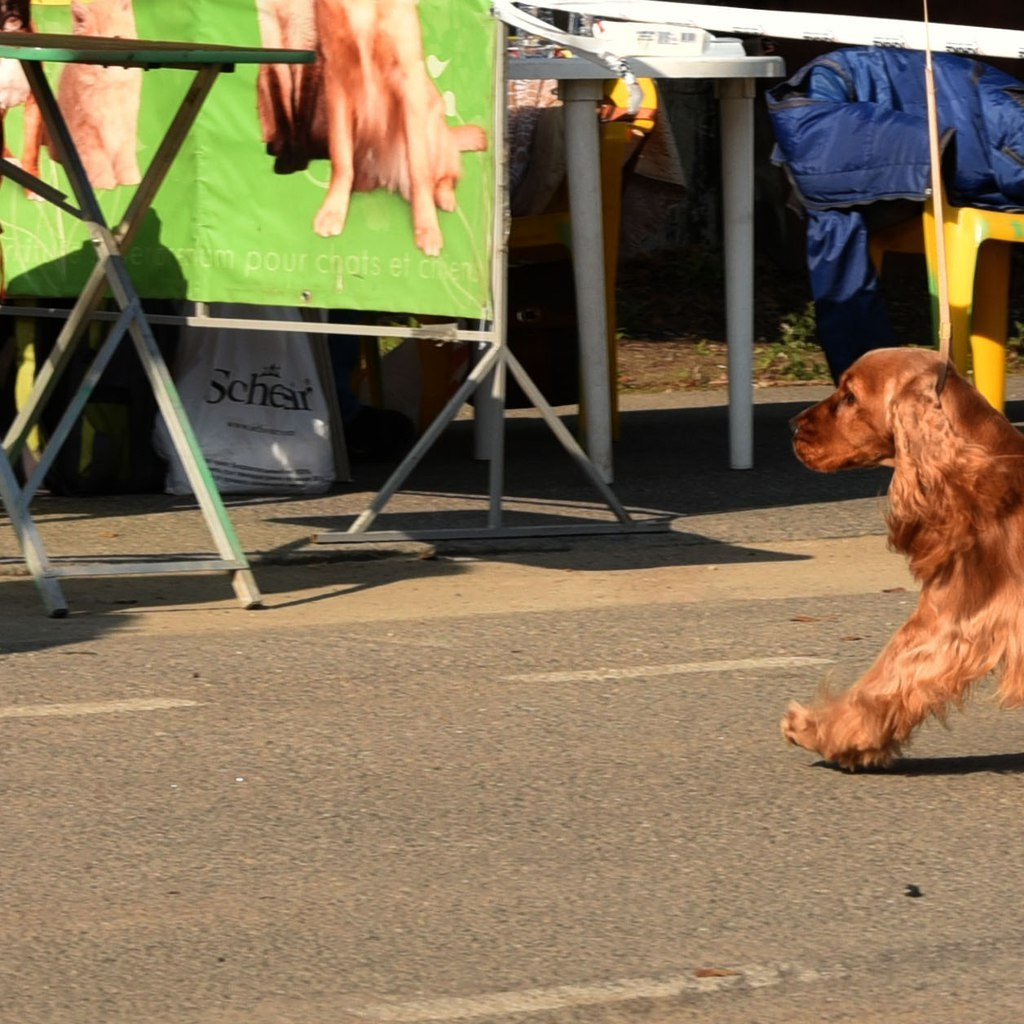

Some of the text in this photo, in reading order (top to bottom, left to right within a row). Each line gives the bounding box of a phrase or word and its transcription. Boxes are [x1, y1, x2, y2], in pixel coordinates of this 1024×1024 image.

[245, 250, 308, 277] pour
[314, 244, 382, 277] chats
[389, 252, 411, 278] et
